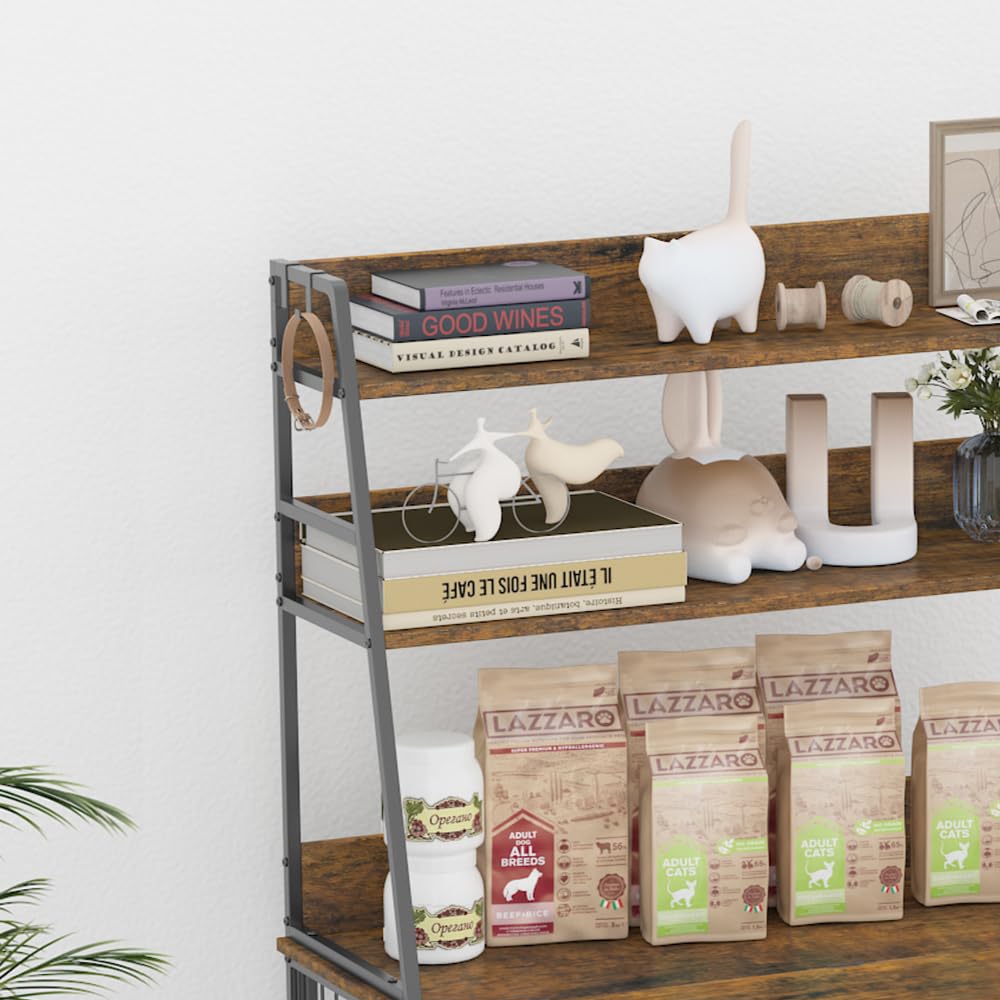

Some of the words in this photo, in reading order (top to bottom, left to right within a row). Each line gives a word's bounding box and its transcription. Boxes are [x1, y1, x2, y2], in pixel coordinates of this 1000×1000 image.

[422, 313, 488, 337] GOOD
[492, 304, 565, 332] WINES
[396, 350, 445, 362] VISUAL
[448, 346, 494, 358] DESIGN
[498, 341, 556, 355] CATALOG
[531, 572, 557, 591] UNE
[561, 568, 597, 590] ÉTAIT
[600, 566, 612, 585] IL
[442, 580, 476, 604] CAFÉ
[479, 578, 495, 597] LE
[498, 575, 527, 595] FOIS
[432, 612, 468, 622] secrets
[469, 608, 497, 618] petits
[498, 608, 509, 616] et
[510, 604, 531, 614] arts
[769, 675, 890, 698] LAZZARO
[633, 692, 754, 715] LAZZARO
[493, 709, 616, 733] LAZZARO
[794, 734, 895, 753] LAZZARO
[655, 752, 758, 772] LAZZARO
[429, 812, 473, 830] Орегано
[936, 819, 974, 830] ADULT
[509, 830, 538, 840] ADULT
[939, 829, 970, 840] CATS
[510, 845, 537, 857] ALL
[800, 838, 839, 849] ADULT
[804, 848, 835, 858] CATS
[500, 856, 546, 868] BREEDS
[662, 857, 701, 868] ADULT
[665, 867, 697, 877] CATS
[431, 920, 474, 937] Орегано
